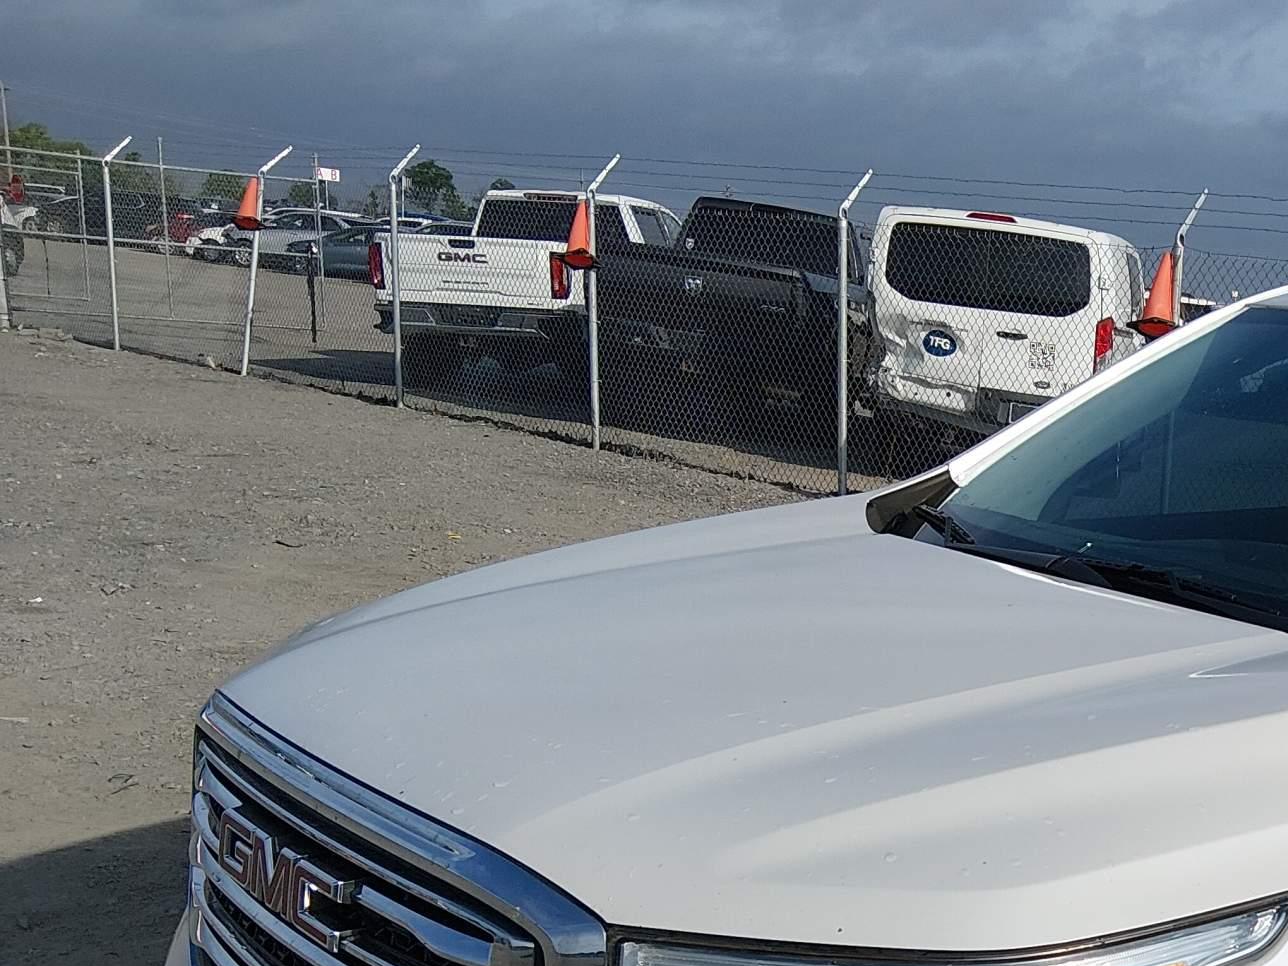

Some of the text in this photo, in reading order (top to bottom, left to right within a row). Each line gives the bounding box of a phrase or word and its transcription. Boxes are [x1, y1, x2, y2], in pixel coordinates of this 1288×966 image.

[438, 252, 488, 263] GMC
[929, 335, 951, 350] TFG
[219, 808, 344, 953] GMC
